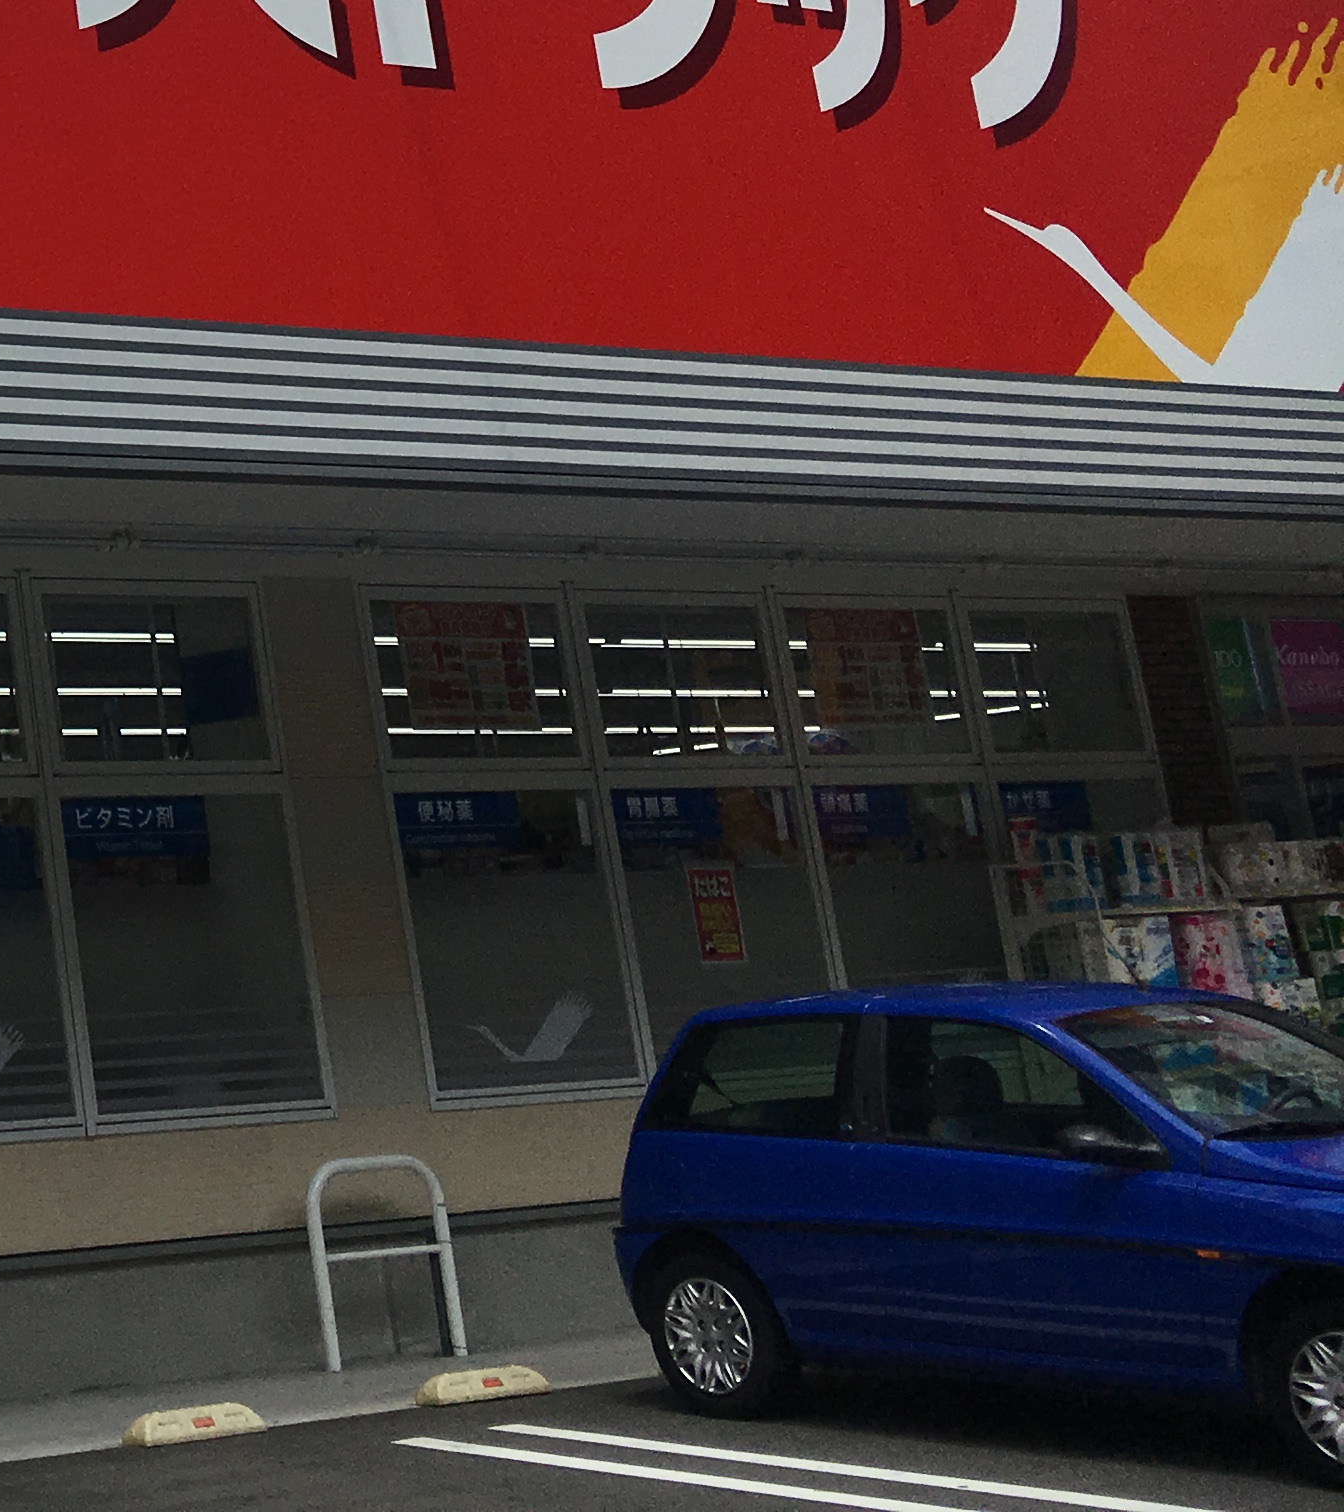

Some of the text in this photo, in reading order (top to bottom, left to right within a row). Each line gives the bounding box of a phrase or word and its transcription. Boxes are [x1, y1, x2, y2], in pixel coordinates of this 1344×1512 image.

[75, 805, 175, 829] ビタミン剤
[417, 799, 474, 823] 便秘薬
